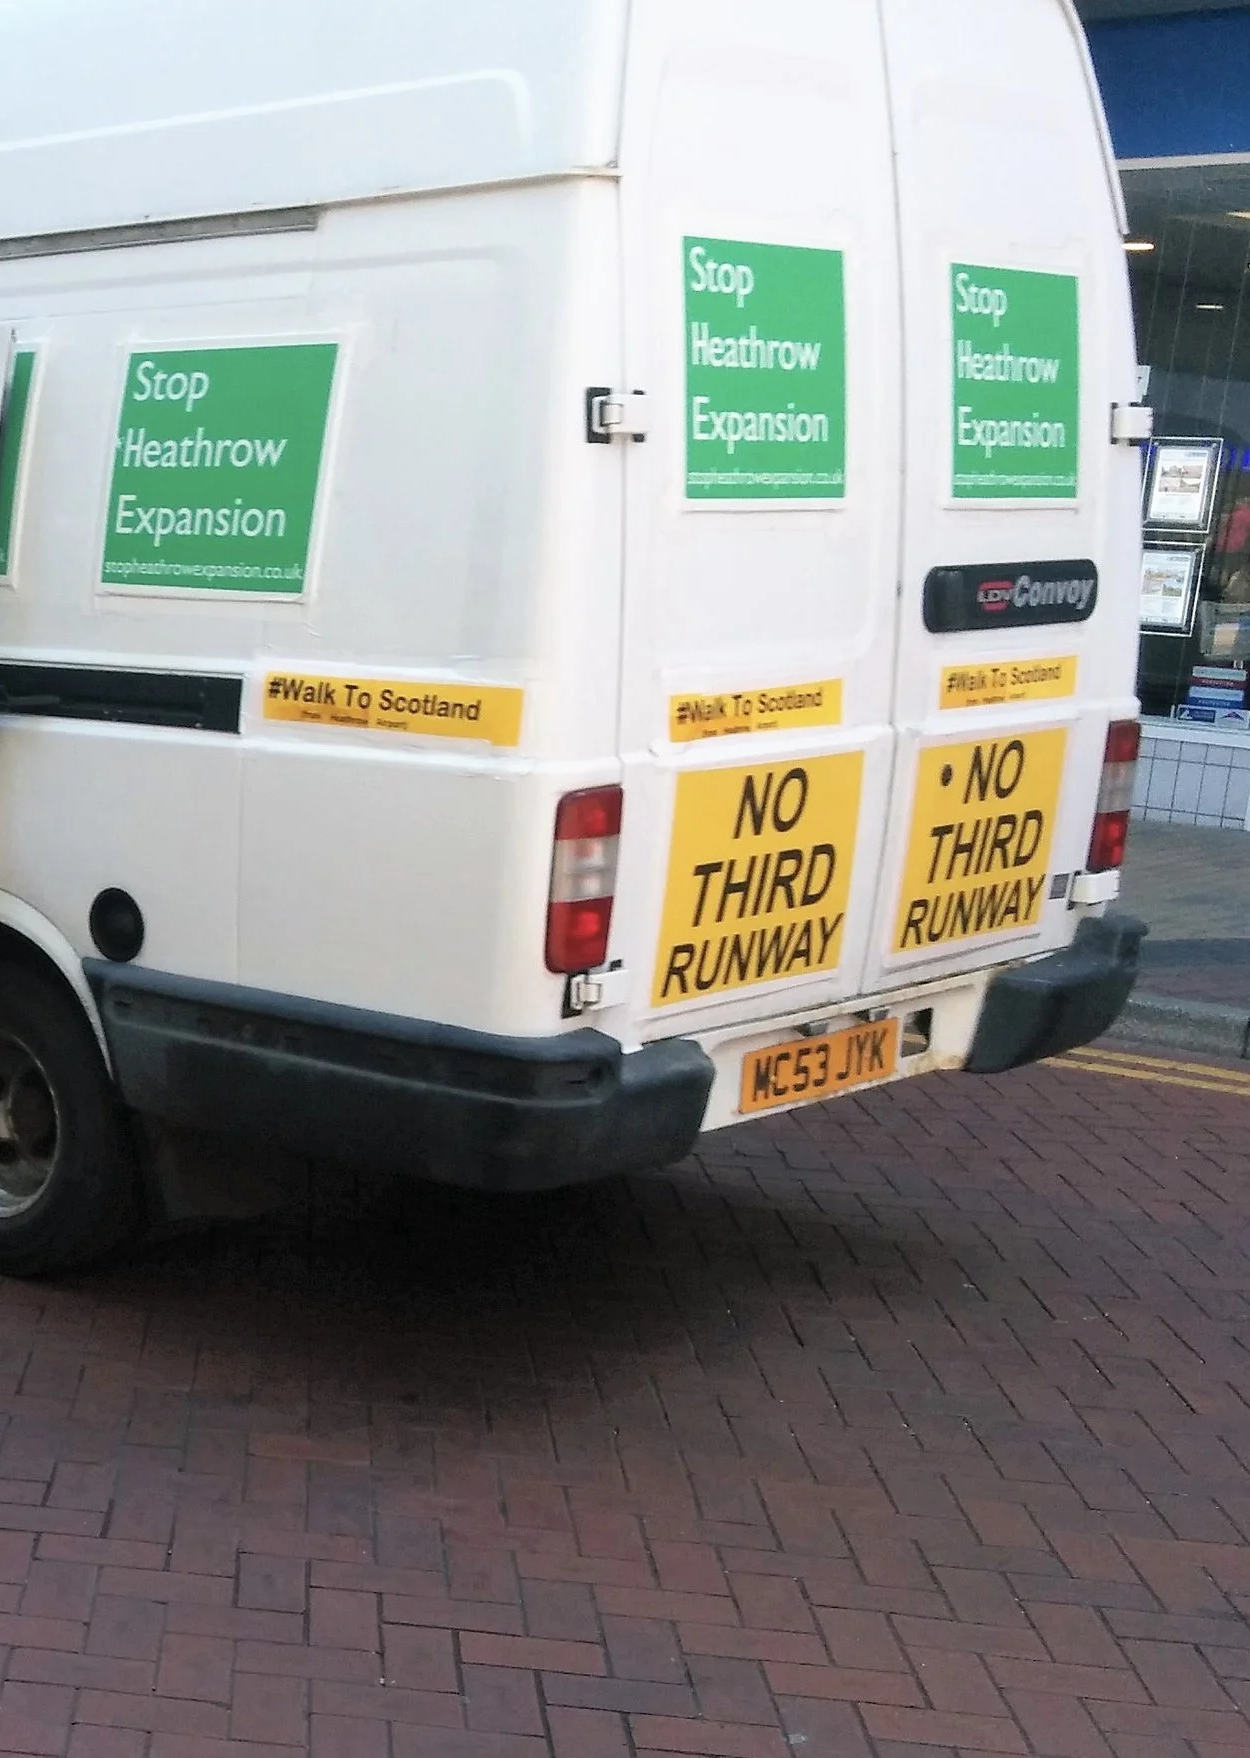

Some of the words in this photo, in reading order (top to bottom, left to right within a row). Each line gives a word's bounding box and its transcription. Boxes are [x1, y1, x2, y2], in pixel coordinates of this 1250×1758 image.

[688, 246, 755, 308] Stop
[956, 273, 1008, 327] Stop
[691, 322, 822, 370] Heathrow
[957, 339, 1061, 384] Heathrow
[133, 360, 210, 412] Stop
[123, 427, 288, 468] Heathrow
[693, 396, 829, 454] Expansion
[957, 406, 1066, 459] Expansion
[115, 494, 286, 547] Expansion
[1013, 575, 1094, 610] Convoy
[268, 676, 336, 706] #Walk
[344, 684, 371, 710] To
[378, 689, 482, 721] Scotland
[991, 668, 1006, 687] To
[1010, 664, 1061, 685] Scotland
[676, 700, 727, 726] #Walk
[732, 694, 752, 716] To
[757, 688, 823, 714] Scotland
[962, 739, 1025, 805] NO
[733, 767, 808, 840] NO
[927, 809, 1043, 884] THIRD
[692, 843, 836, 927] THIRD
[900, 873, 1046, 948] RUNWAY
[660, 912, 844, 998] RUNWAY
[752, 1043, 830, 1101] MC53
[836, 1027, 889, 1081] JYK
